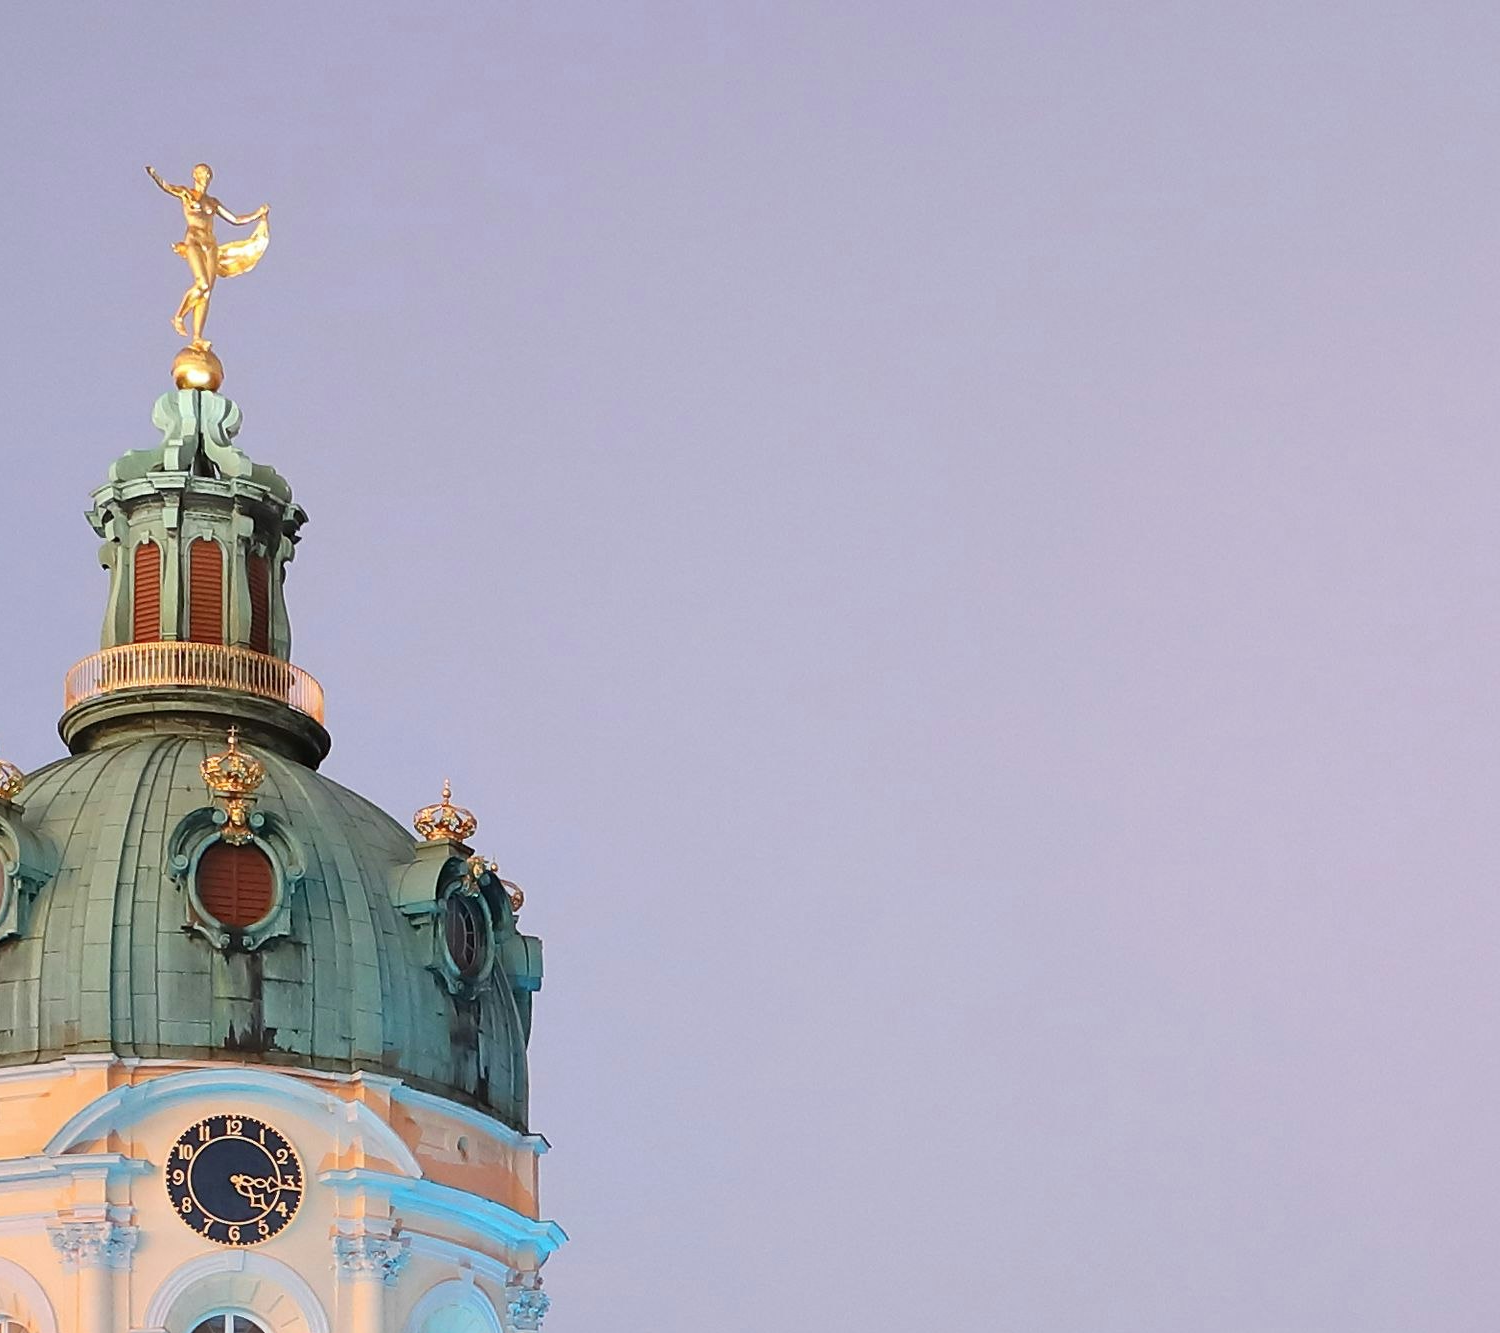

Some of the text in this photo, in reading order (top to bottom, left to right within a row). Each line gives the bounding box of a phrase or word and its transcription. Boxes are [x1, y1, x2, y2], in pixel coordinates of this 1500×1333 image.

[199, 1125, 210, 1141] 11
[226, 1120, 242, 1135] 12
[259, 1129, 265, 1144] 1
[179, 1144, 193, 1160] 10
[276, 1149, 289, 1164] 2
[172, 1170, 185, 1185] 9
[284, 1175, 295, 1188] 3
[182, 1197, 192, 1213] 8
[276, 1202, 288, 1217] 4
[203, 1219, 214, 1233] 7
[228, 1226, 240, 1241] 6
[258, 1221, 269, 1235] 5
